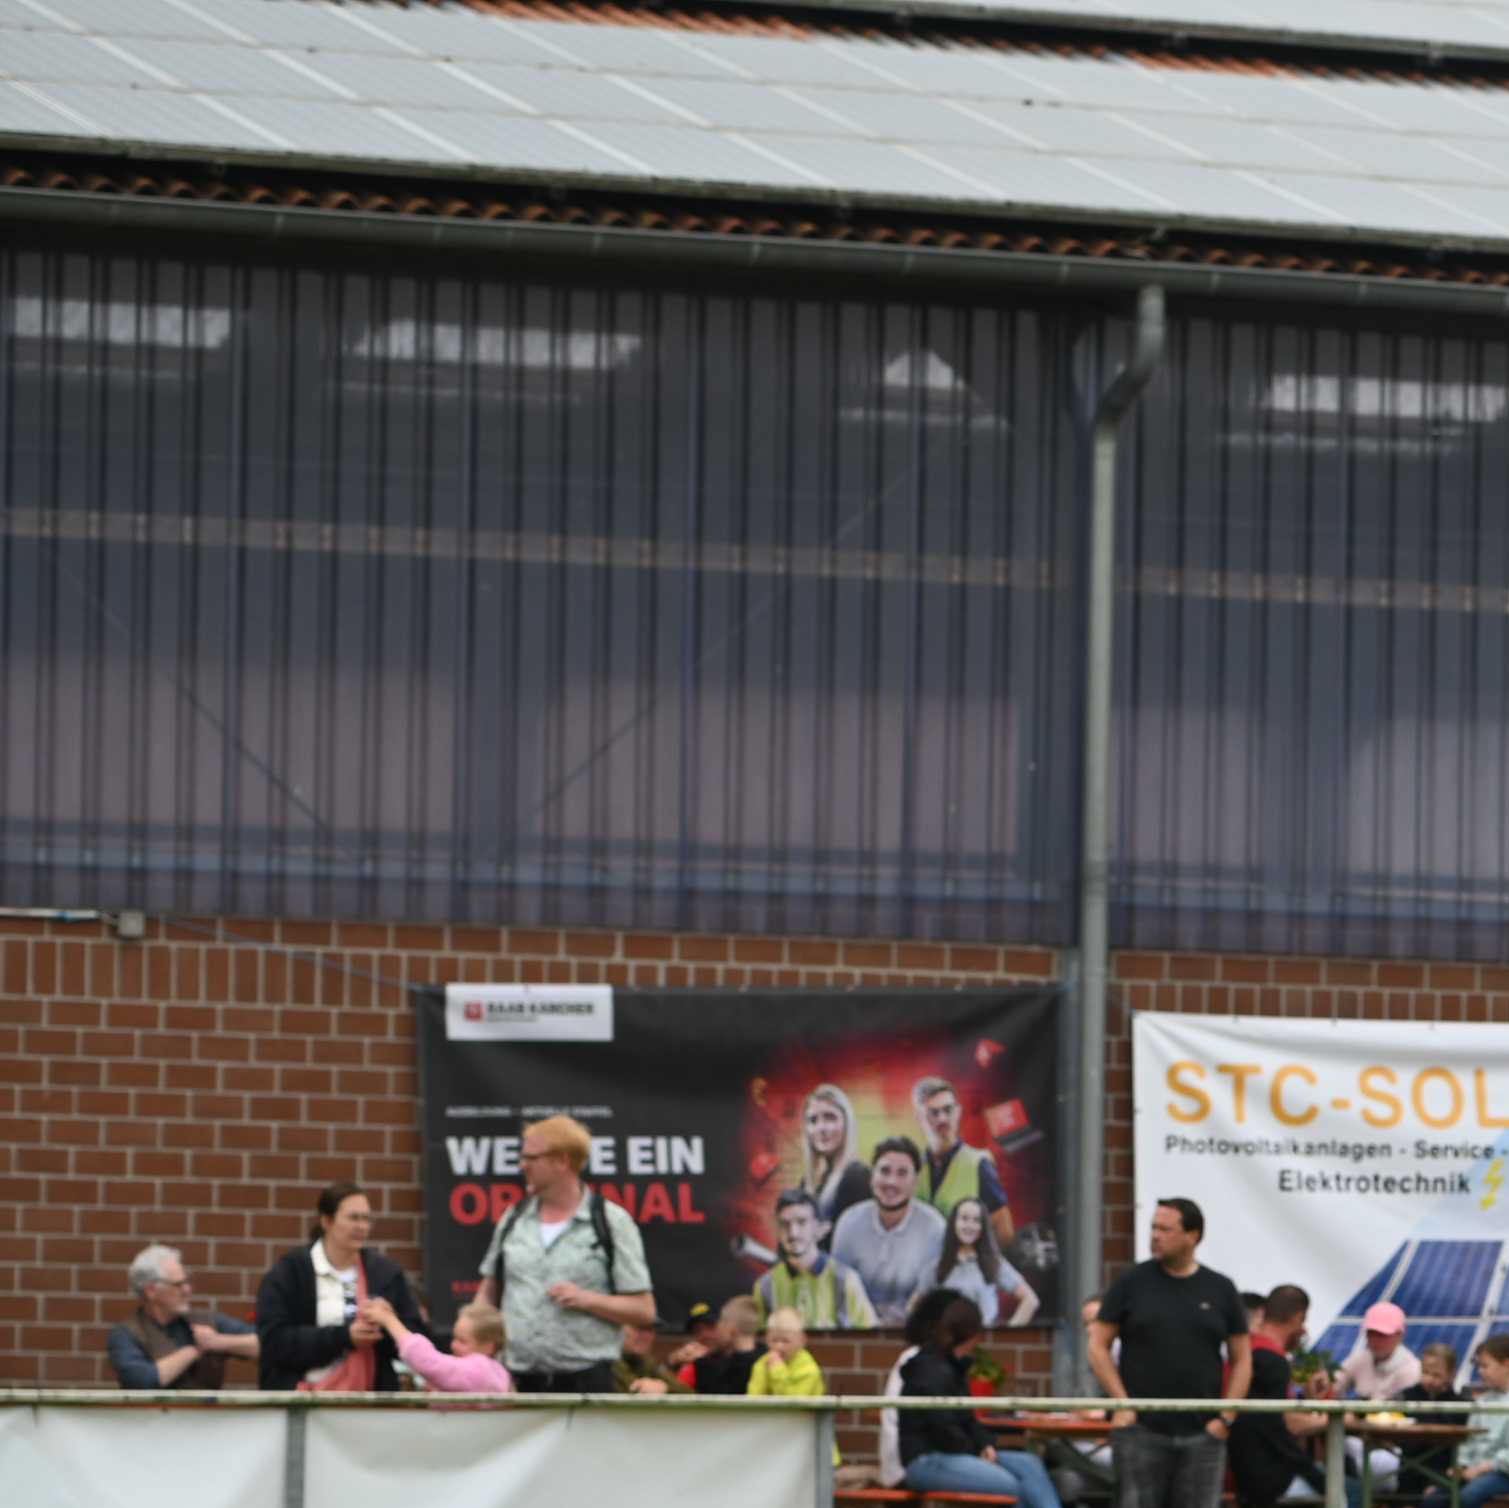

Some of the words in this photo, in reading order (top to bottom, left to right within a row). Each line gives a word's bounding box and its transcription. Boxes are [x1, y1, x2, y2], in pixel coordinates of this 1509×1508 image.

[446, 1136, 617, 1175] WEE
[627, 1137, 704, 1175] EIN
[1413, 1140, 1495, 1159] Service
[1278, 1169, 1470, 1195] Elektrotechnik
[450, 1181, 705, 1225] ORNAL
